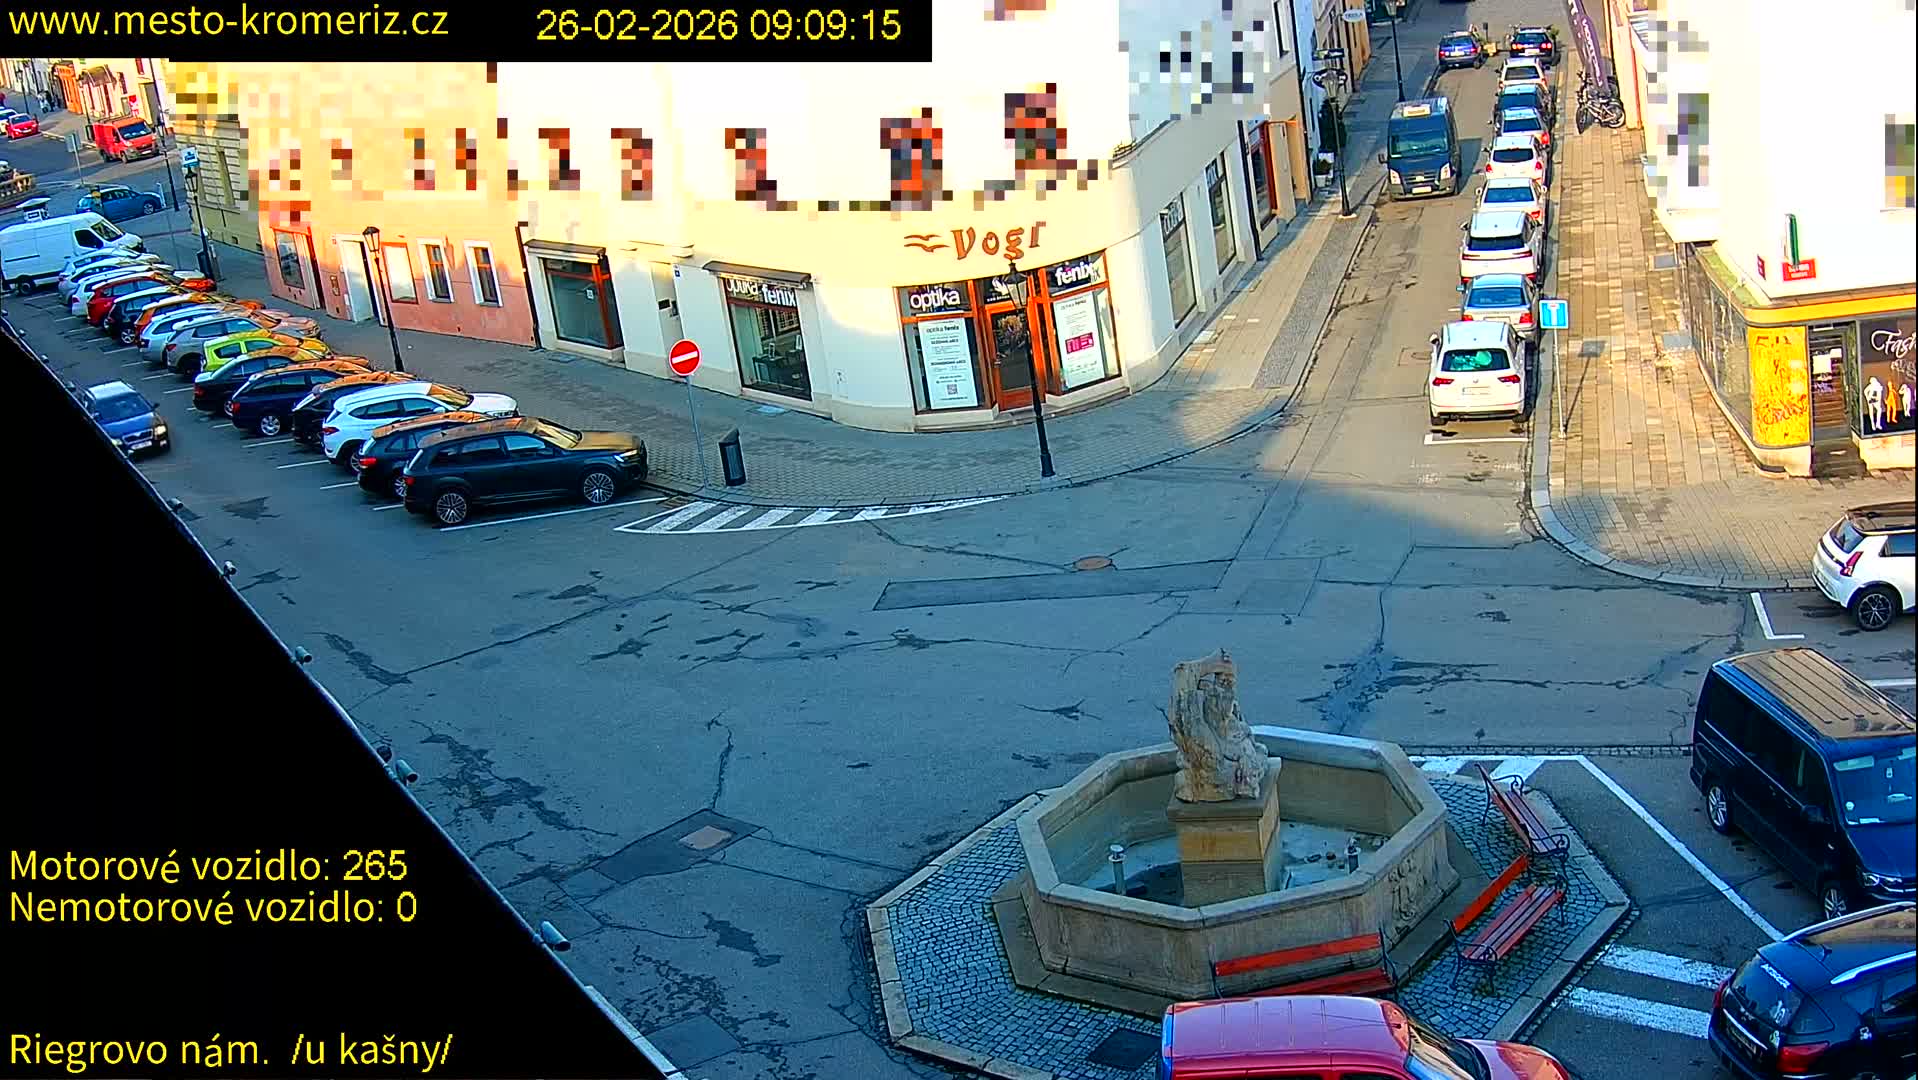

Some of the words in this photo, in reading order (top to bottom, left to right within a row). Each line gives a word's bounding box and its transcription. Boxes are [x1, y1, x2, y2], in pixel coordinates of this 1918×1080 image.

[1055, 261, 1095, 287] fenix
[761, 284, 797, 307] fenix
[909, 288, 961, 310] optika
